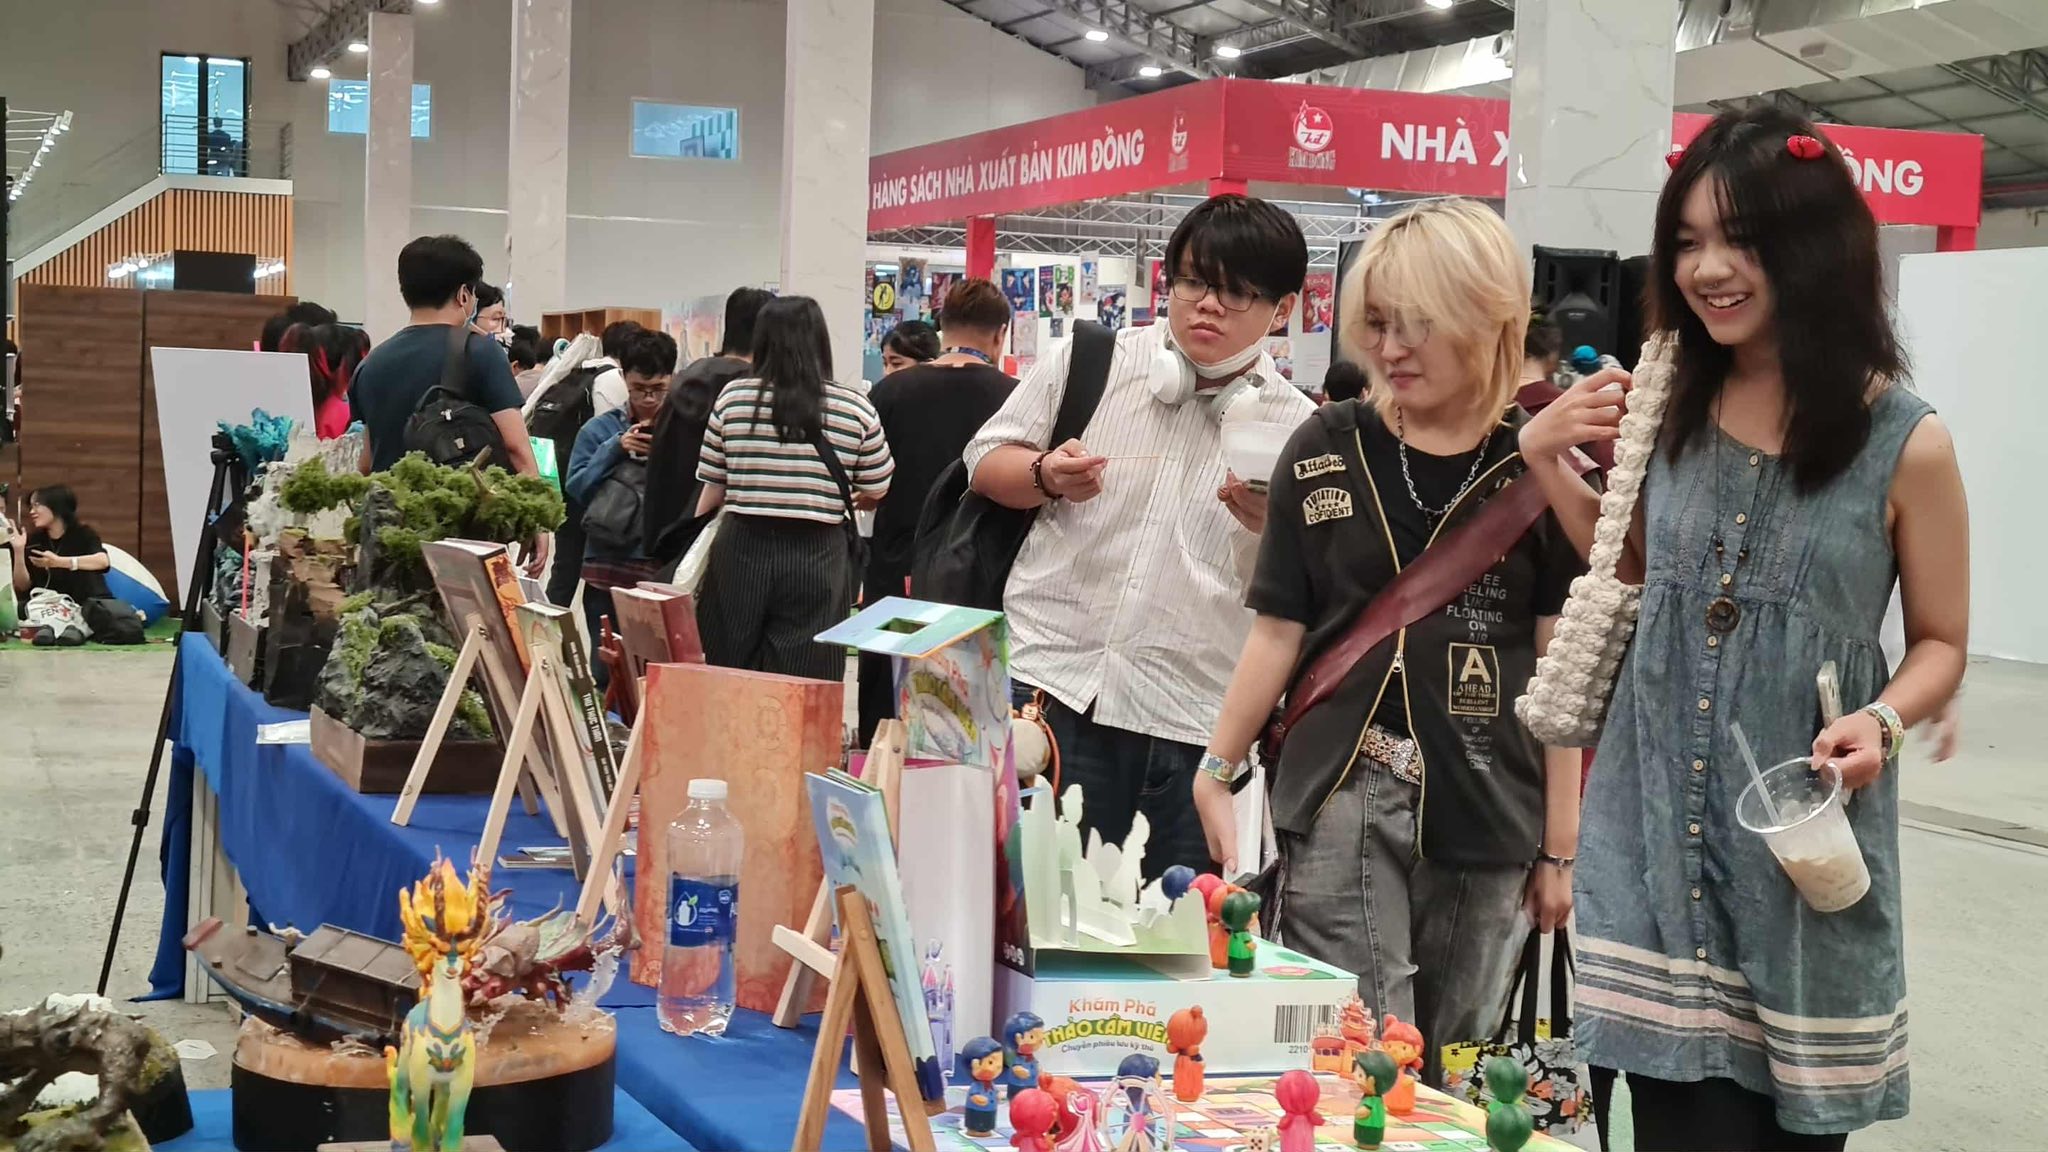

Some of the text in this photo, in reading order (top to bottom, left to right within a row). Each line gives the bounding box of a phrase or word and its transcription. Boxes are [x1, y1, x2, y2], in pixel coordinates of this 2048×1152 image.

[1381, 117, 1477, 166] NHÀ
[872, 173, 907, 210] HÀNG
[910, 165, 942, 204] SÁCH
[945, 155, 974, 198] NHÀ
[978, 146, 1016, 192] XUẤT
[1020, 140, 1052, 185] BẢN
[1057, 141, 1087, 179] KIM
[1091, 125, 1144, 172] ĐỒNG
[1308, 506, 1350, 523] COFIDENT
[1464, 594, 1493, 609] LIKE
[1446, 604, 1503, 623] FLOATING
[1459, 647, 1492, 683] A
[1457, 684, 1491, 694] AHEAD
[1069, 998, 1157, 1017] Khám Phá
[1096, 1013, 1133, 1036] CẦM
[1136, 1020, 1170, 1045] VIÊ
[1288, 1045, 1309, 1054] 2210
